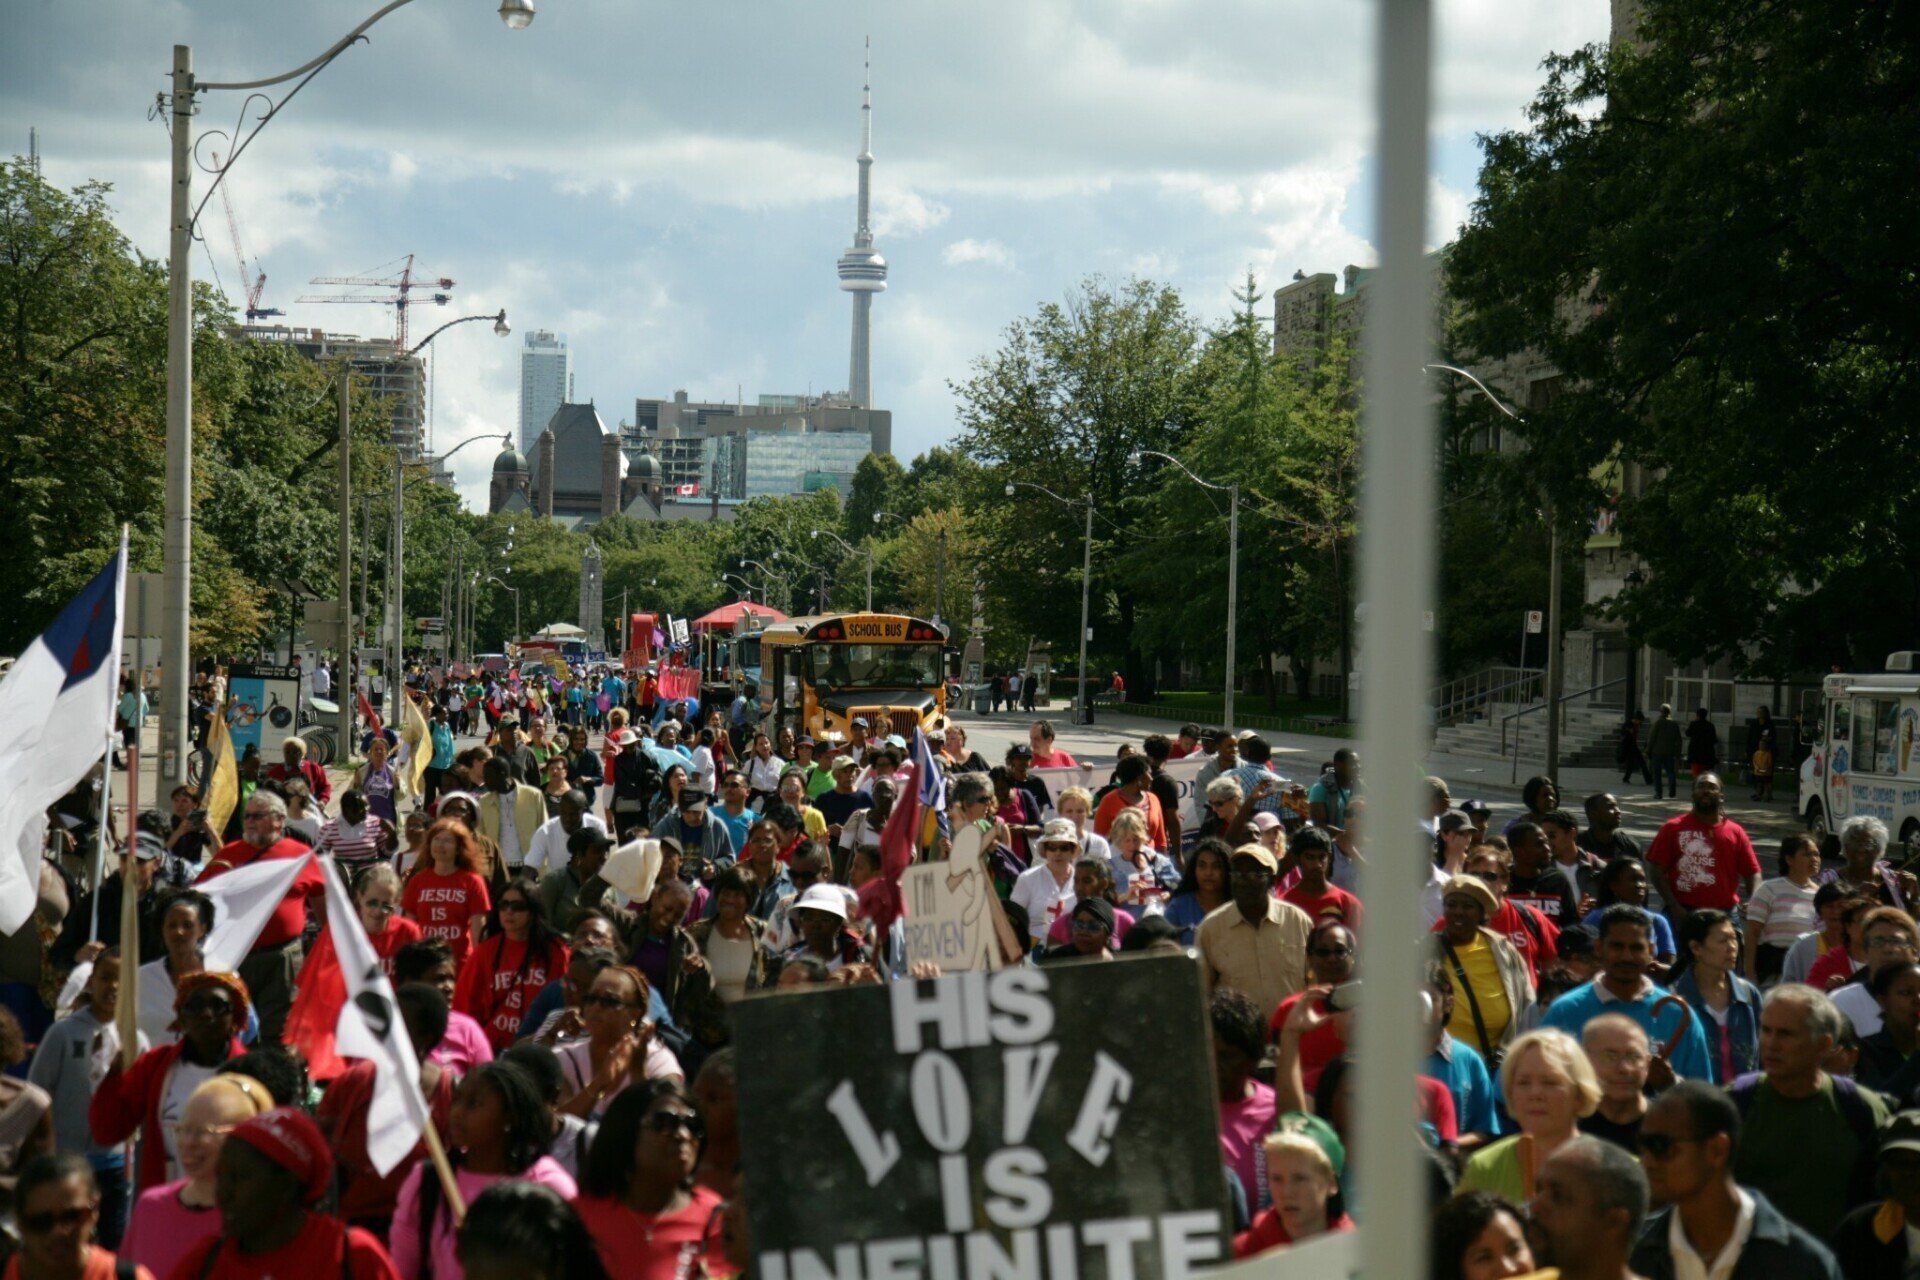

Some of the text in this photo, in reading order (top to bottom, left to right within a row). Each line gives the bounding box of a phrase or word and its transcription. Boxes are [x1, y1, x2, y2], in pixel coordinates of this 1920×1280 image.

[849, 623, 902, 637] SCHOOL BUS
[1679, 830, 1706, 840] ZEAL
[417, 887, 467, 904] JESUS
[431, 906, 447, 921] IS
[505, 991, 522, 1009] IS
[891, 967, 1057, 1054] HIS
[826, 1041, 1134, 1188] LOVE
[938, 1145, 1055, 1233] IS
